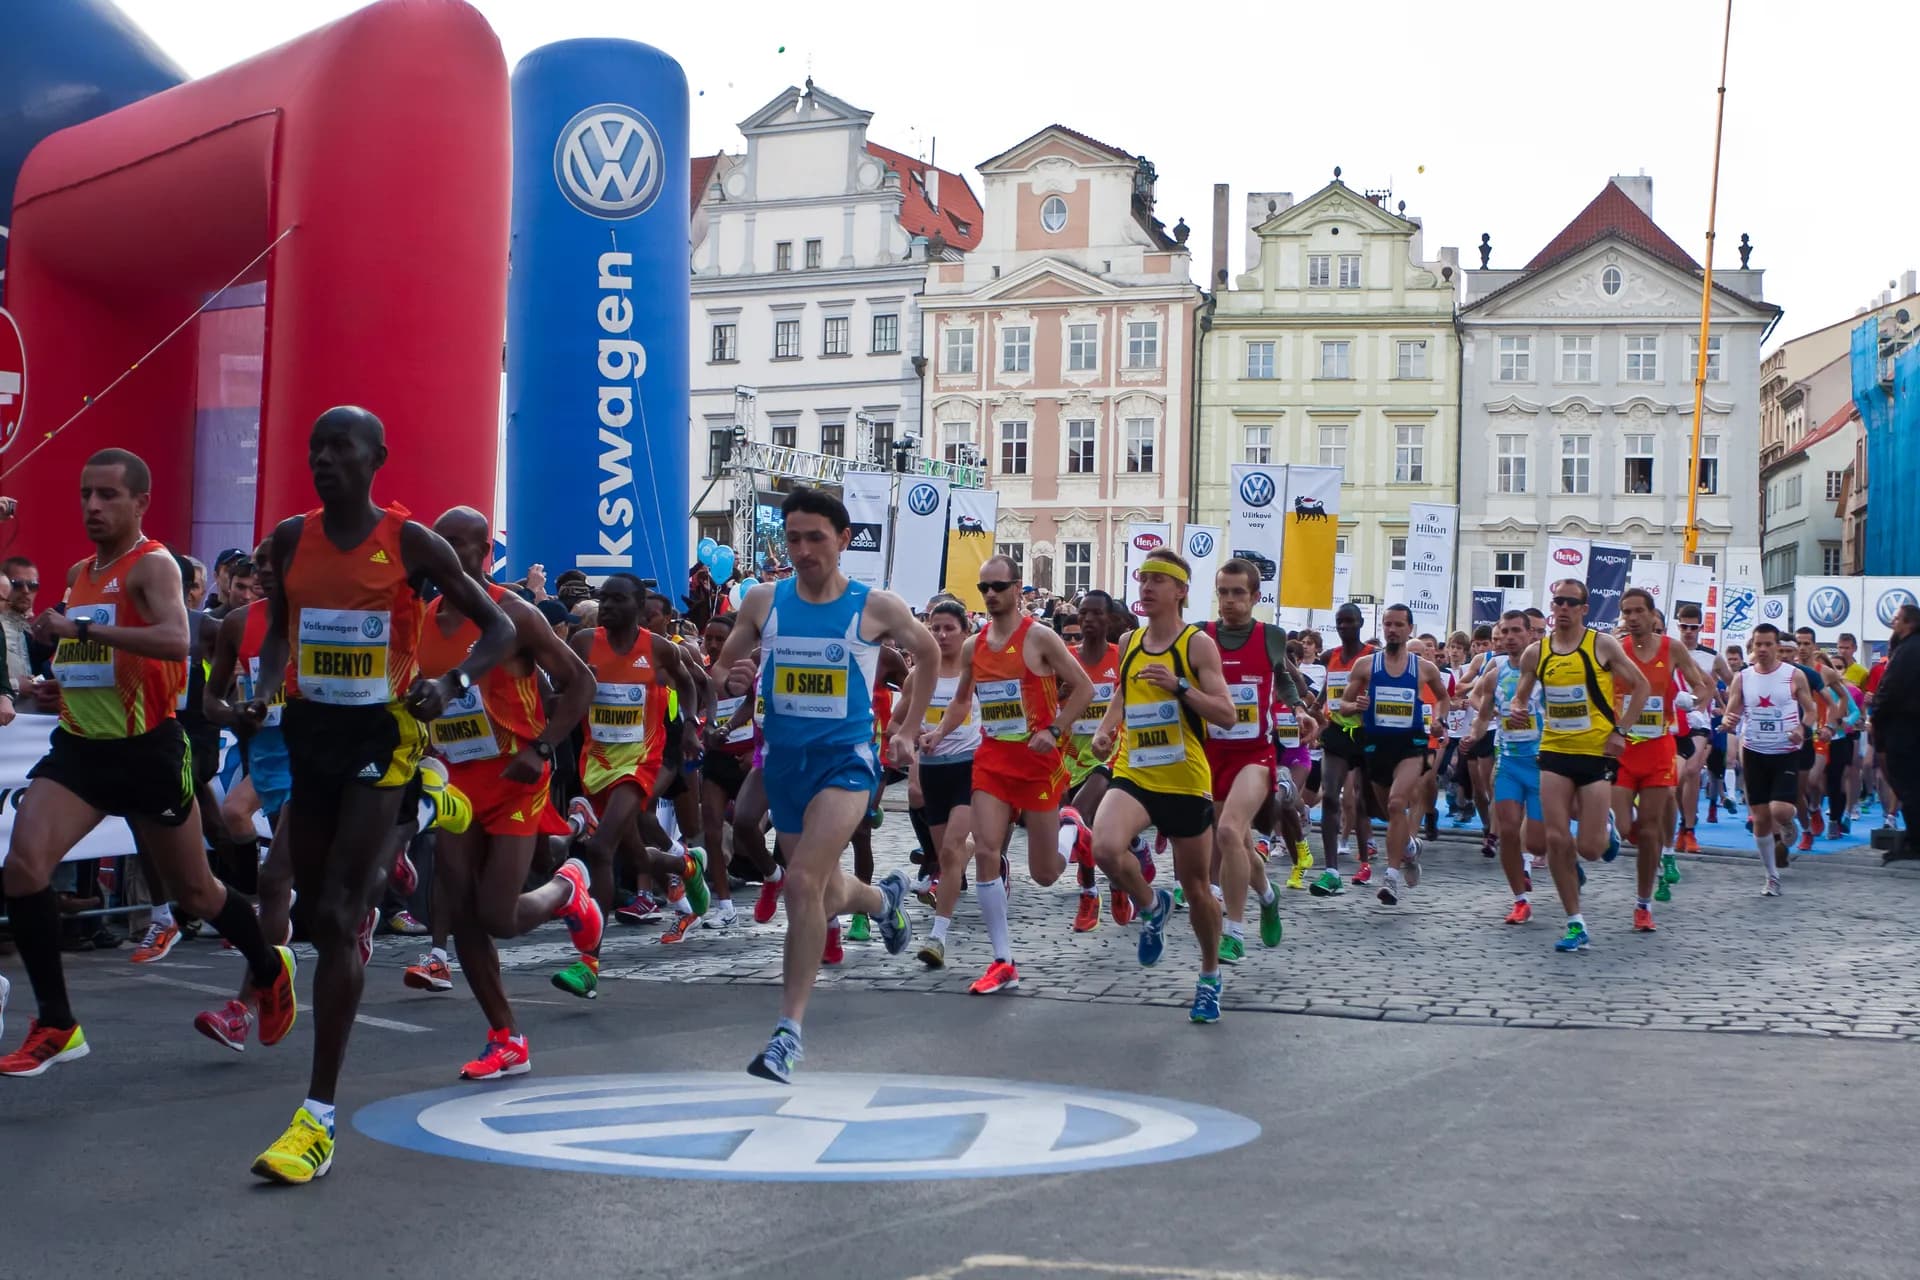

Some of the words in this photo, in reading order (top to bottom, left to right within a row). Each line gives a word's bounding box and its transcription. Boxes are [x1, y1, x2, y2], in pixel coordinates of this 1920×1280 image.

[1415, 523, 1446, 535] Hilton
[850, 539, 877, 548] adidas
[1412, 561, 1443, 573] Hilton
[1409, 600, 1439, 611] Hilton
[303, 621, 358, 633] Volkswagen
[776, 648, 822, 658] Volkswagen
[313, 651, 372, 677] EBENYO
[798, 673, 833, 695] SHEA
[594, 708, 639, 725] KIBIWOT
[435, 719, 482, 742] CHIMSA
[1760, 721, 1776, 732] 125
